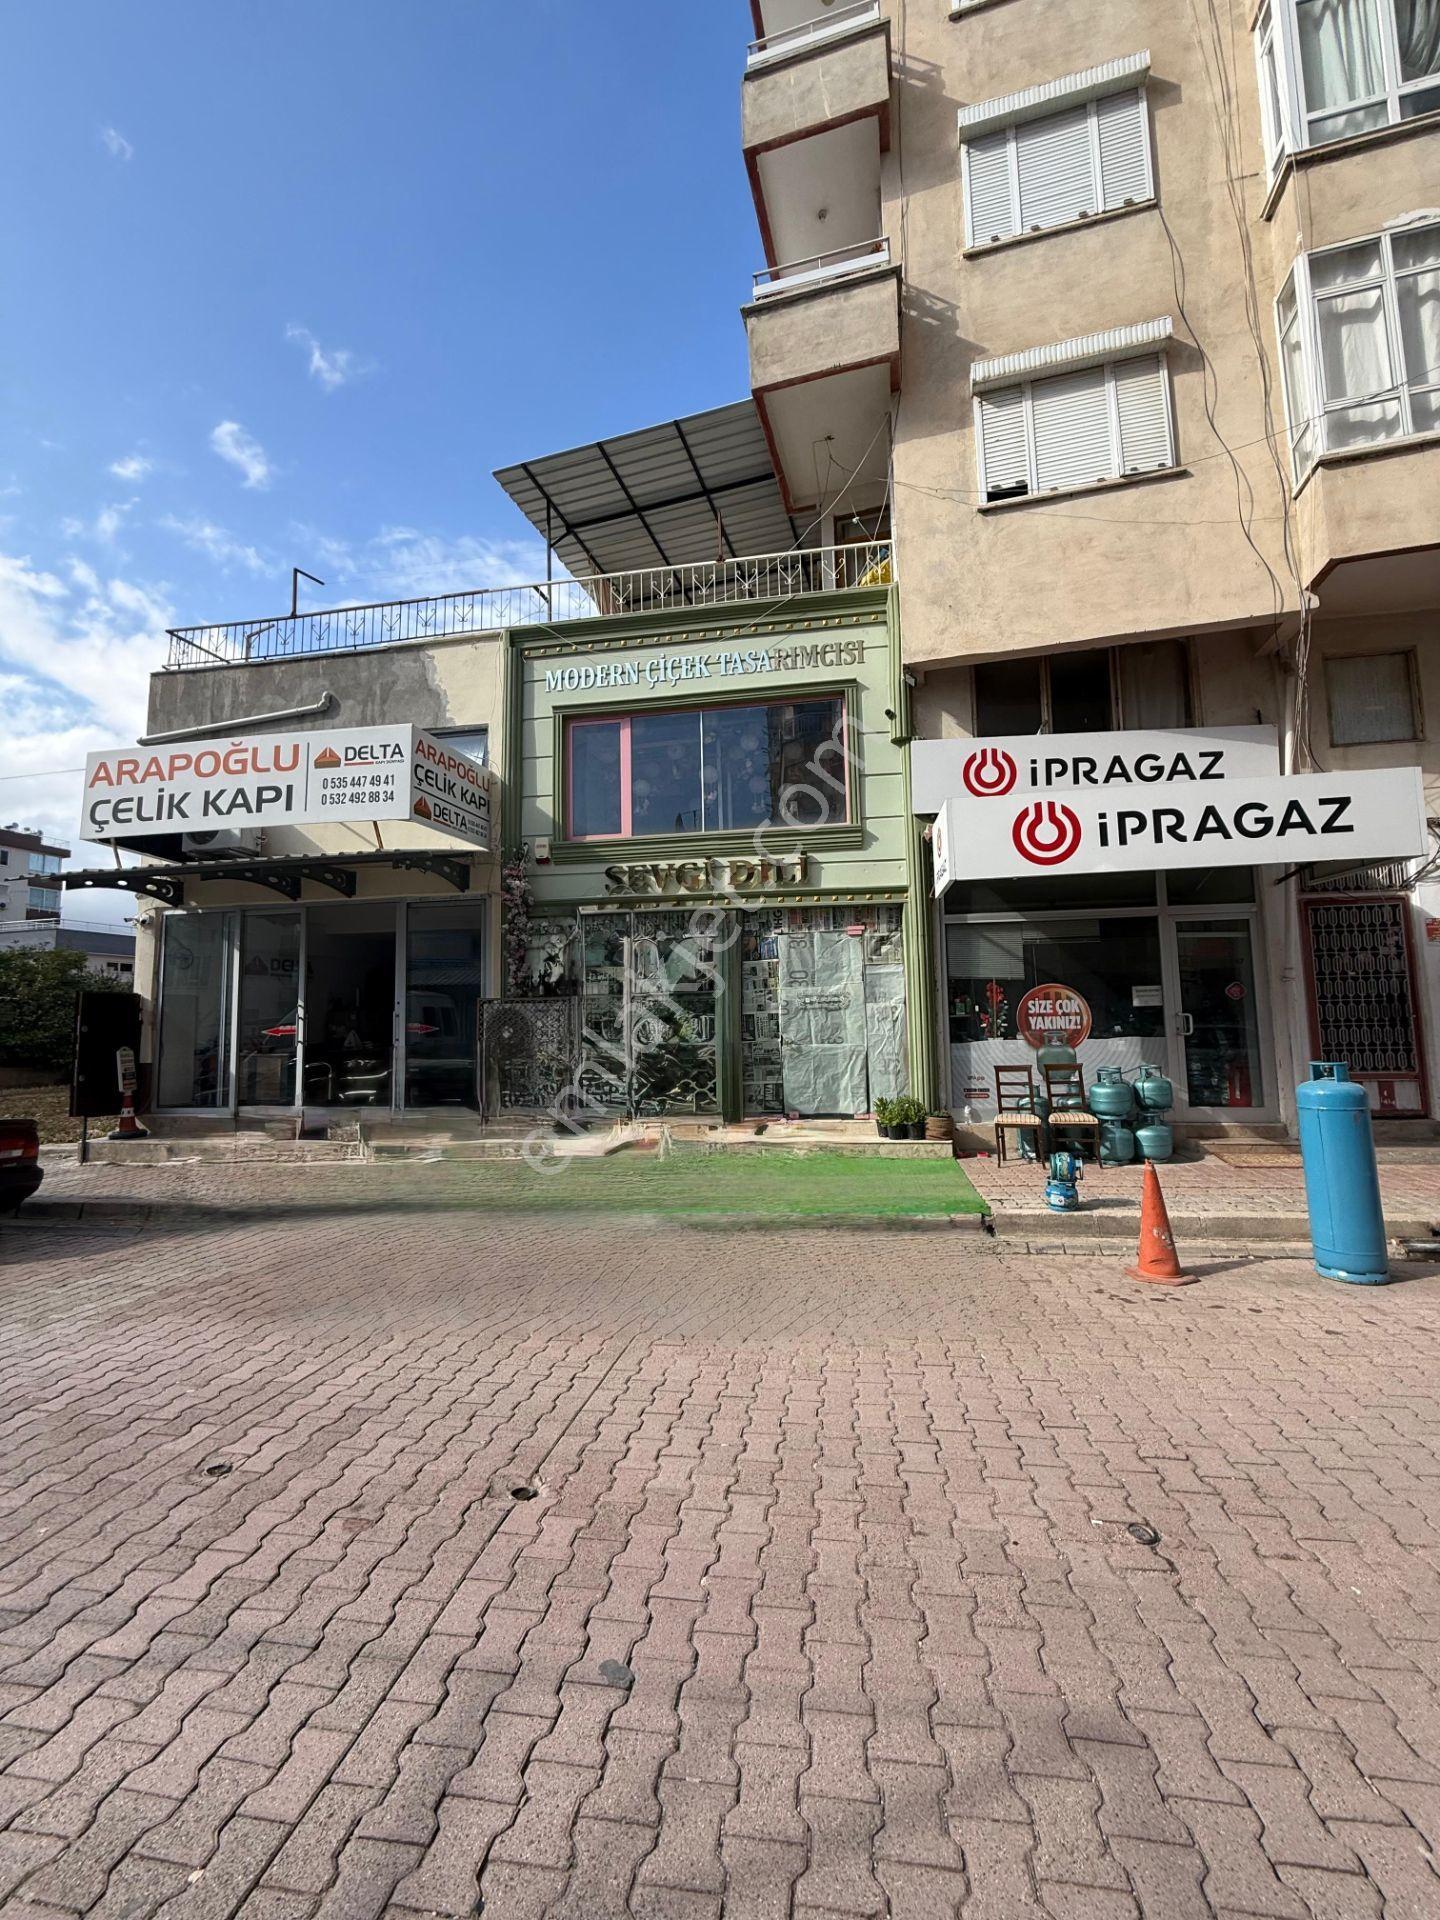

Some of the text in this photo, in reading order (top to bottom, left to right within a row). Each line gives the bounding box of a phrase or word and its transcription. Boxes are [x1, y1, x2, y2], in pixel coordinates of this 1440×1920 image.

[545, 640, 865, 693] MODERN ÇİÇEK TASARIMCISI
[88, 741, 300, 789] ARAPOĞLU
[344, 743, 405, 762] DELTA
[415, 739, 490, 792] ARAPOĞLU
[322, 774, 395, 790] 0 535 447 49 41
[414, 763, 490, 815] ÇELİK KAPI
[89, 784, 294, 833] ÇELİK KAPI
[321, 790, 394, 806] 0 532 492 88 34
[433, 803, 468, 830] DELTA
[1027, 997, 1080, 1015] SİZE ÇOK
[1028, 1015, 1082, 1030] YAKINIZ!
